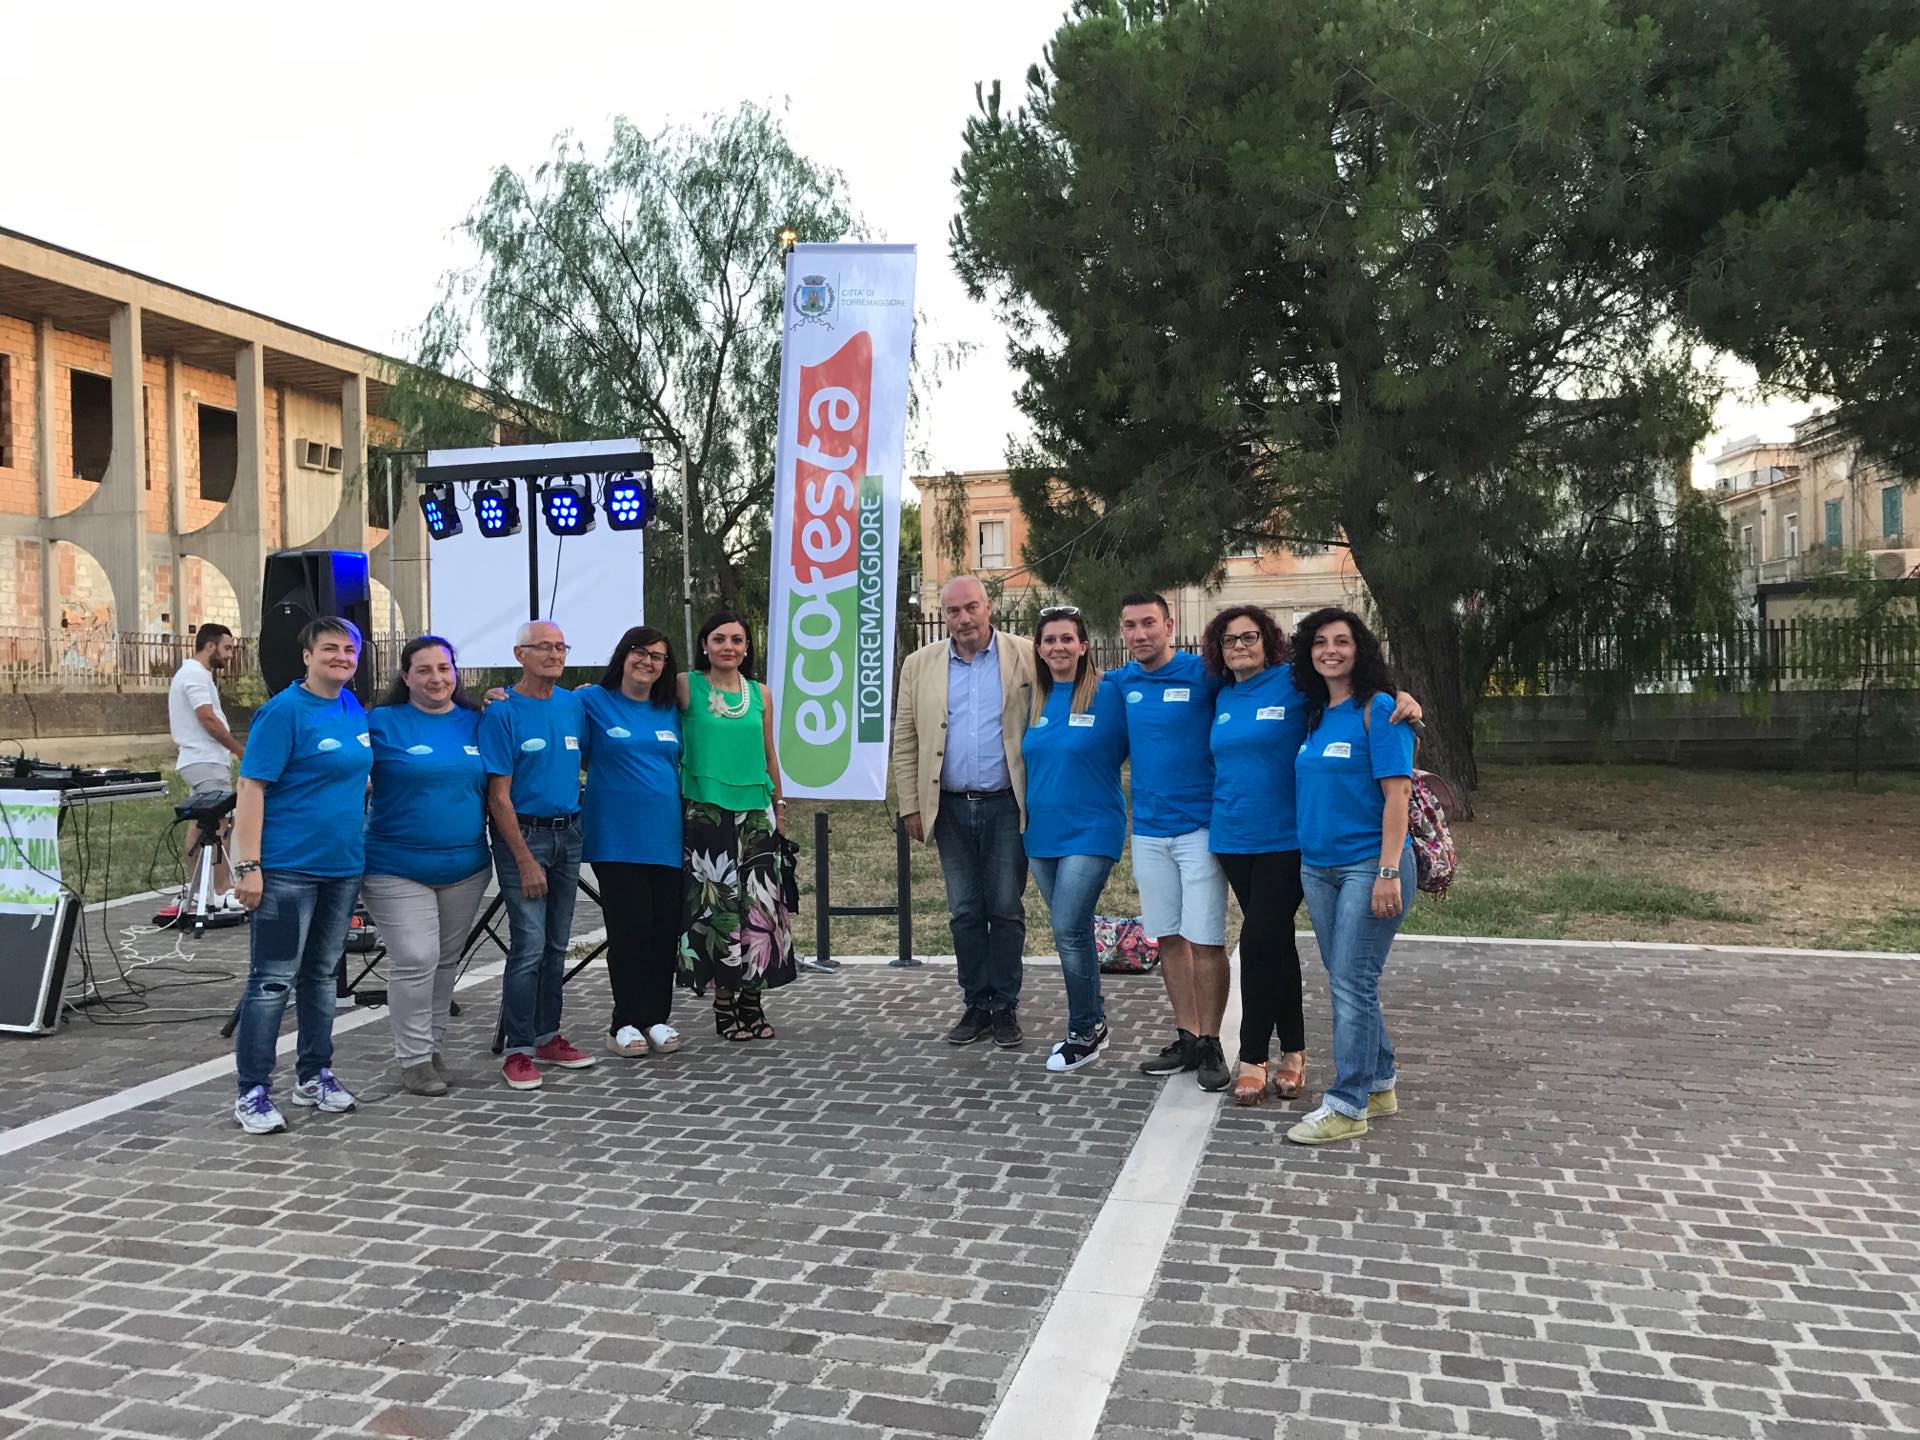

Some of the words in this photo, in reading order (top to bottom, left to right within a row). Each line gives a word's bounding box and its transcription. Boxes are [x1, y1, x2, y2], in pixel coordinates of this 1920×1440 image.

[866, 289, 875, 297] DI
[789, 386, 858, 745] ecofesta
[860, 495, 881, 724] TORREMAGGIORE
[28, 838, 58, 870] MIA
